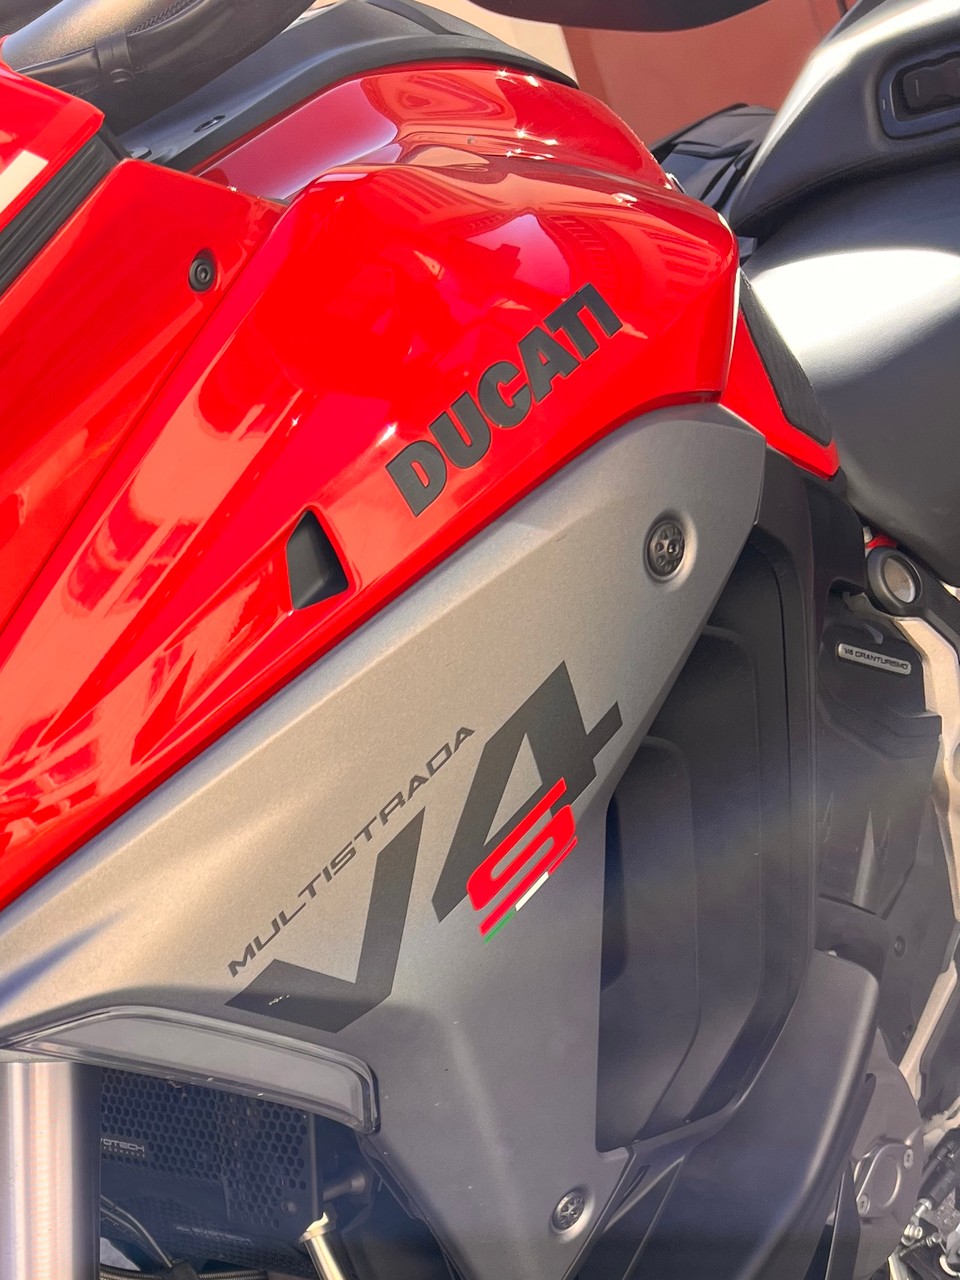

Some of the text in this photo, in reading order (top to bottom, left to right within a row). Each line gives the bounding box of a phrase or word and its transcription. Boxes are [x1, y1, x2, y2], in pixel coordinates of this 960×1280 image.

[385, 282, 624, 518] DUCATI
[855, 650, 909, 670] GRANTURISMO
[224, 660, 623, 1034] V4 S
[227, 726, 476, 978] MULTISTRADA
[100, 1137, 145, 1152] OTECH
